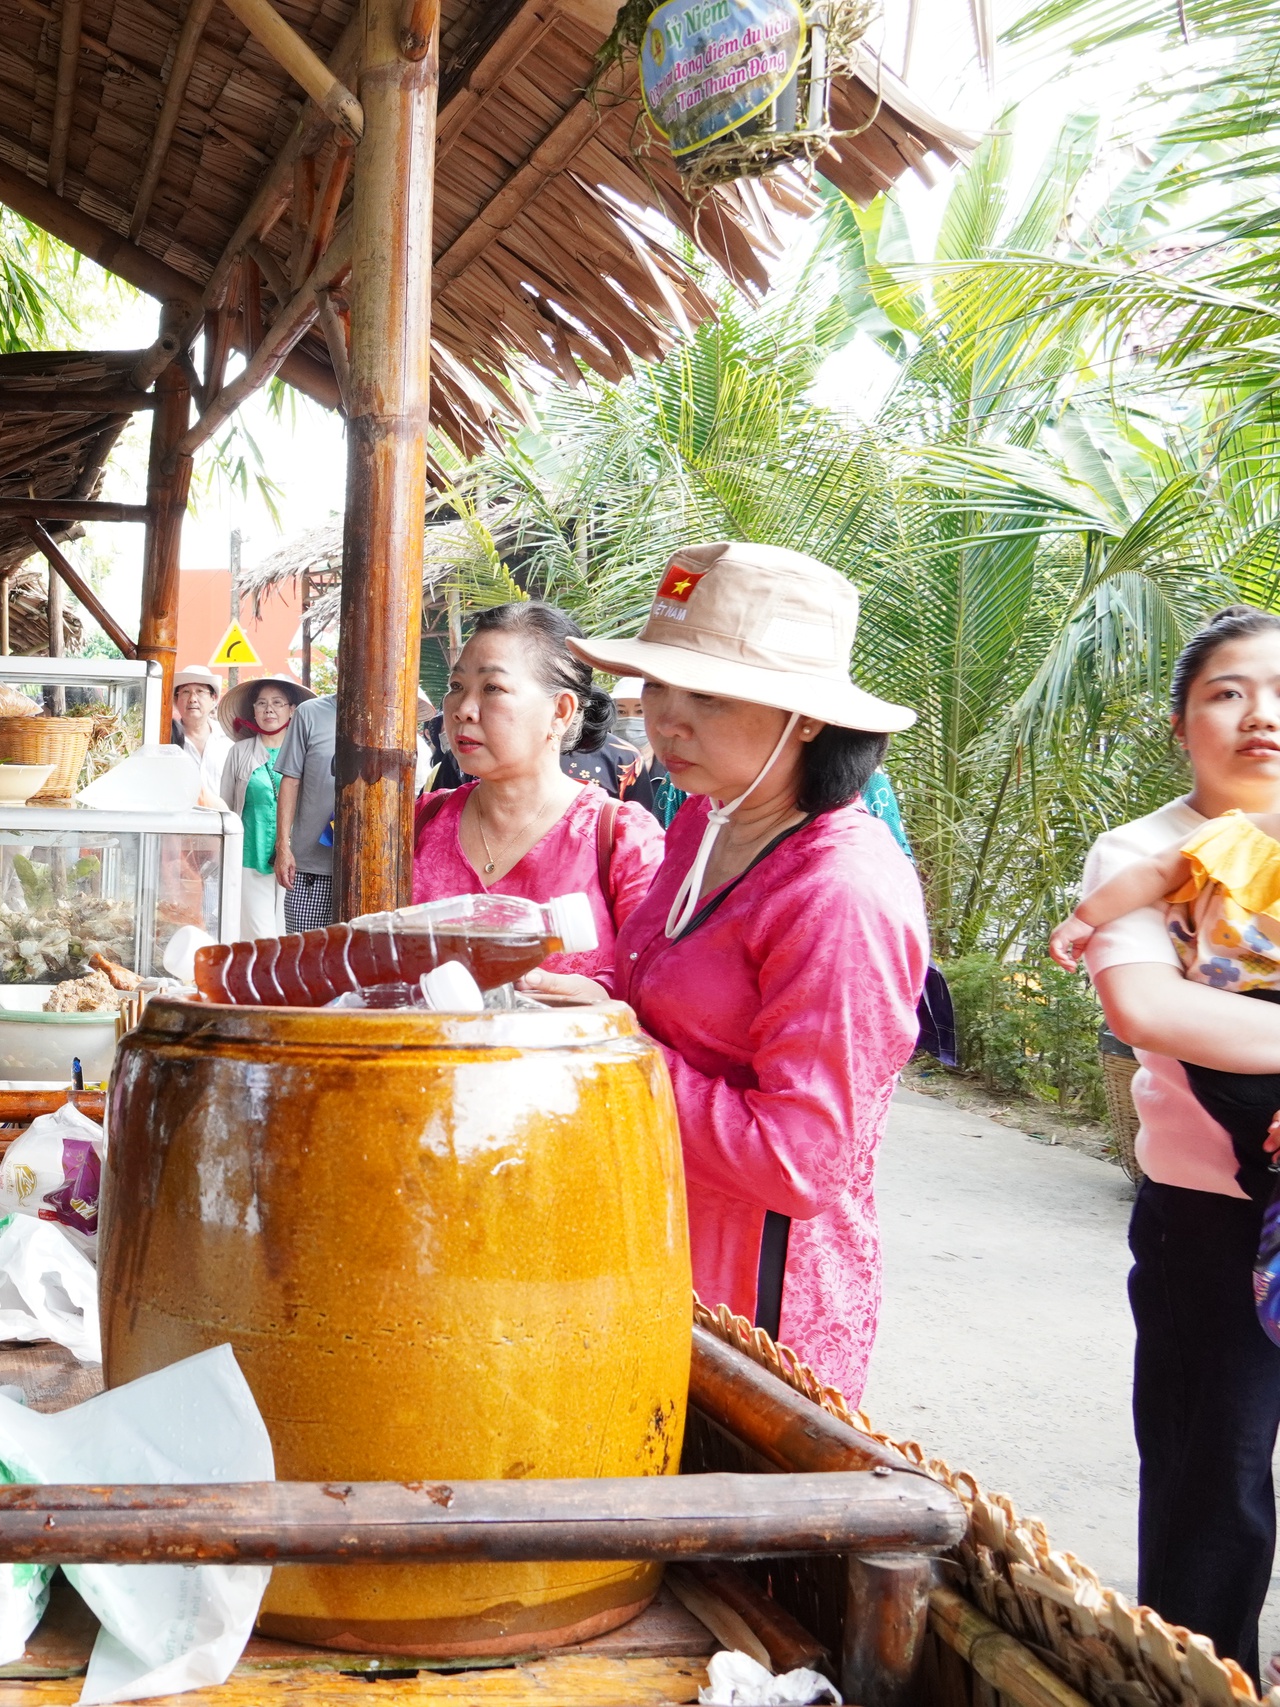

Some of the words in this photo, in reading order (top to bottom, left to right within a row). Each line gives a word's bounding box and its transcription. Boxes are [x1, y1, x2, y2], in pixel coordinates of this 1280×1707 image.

[683, 0, 730, 35] Niệm
[673, 54, 703, 83] động
[704, 33, 740, 65] điểm
[742, 27, 761, 48] du
[764, 17, 790, 43] lịch
[677, 88, 701, 112] Tân
[703, 67, 747, 98] Thuận
[748, 52, 786, 79] Đông
[664, 605, 687, 621] NAM
